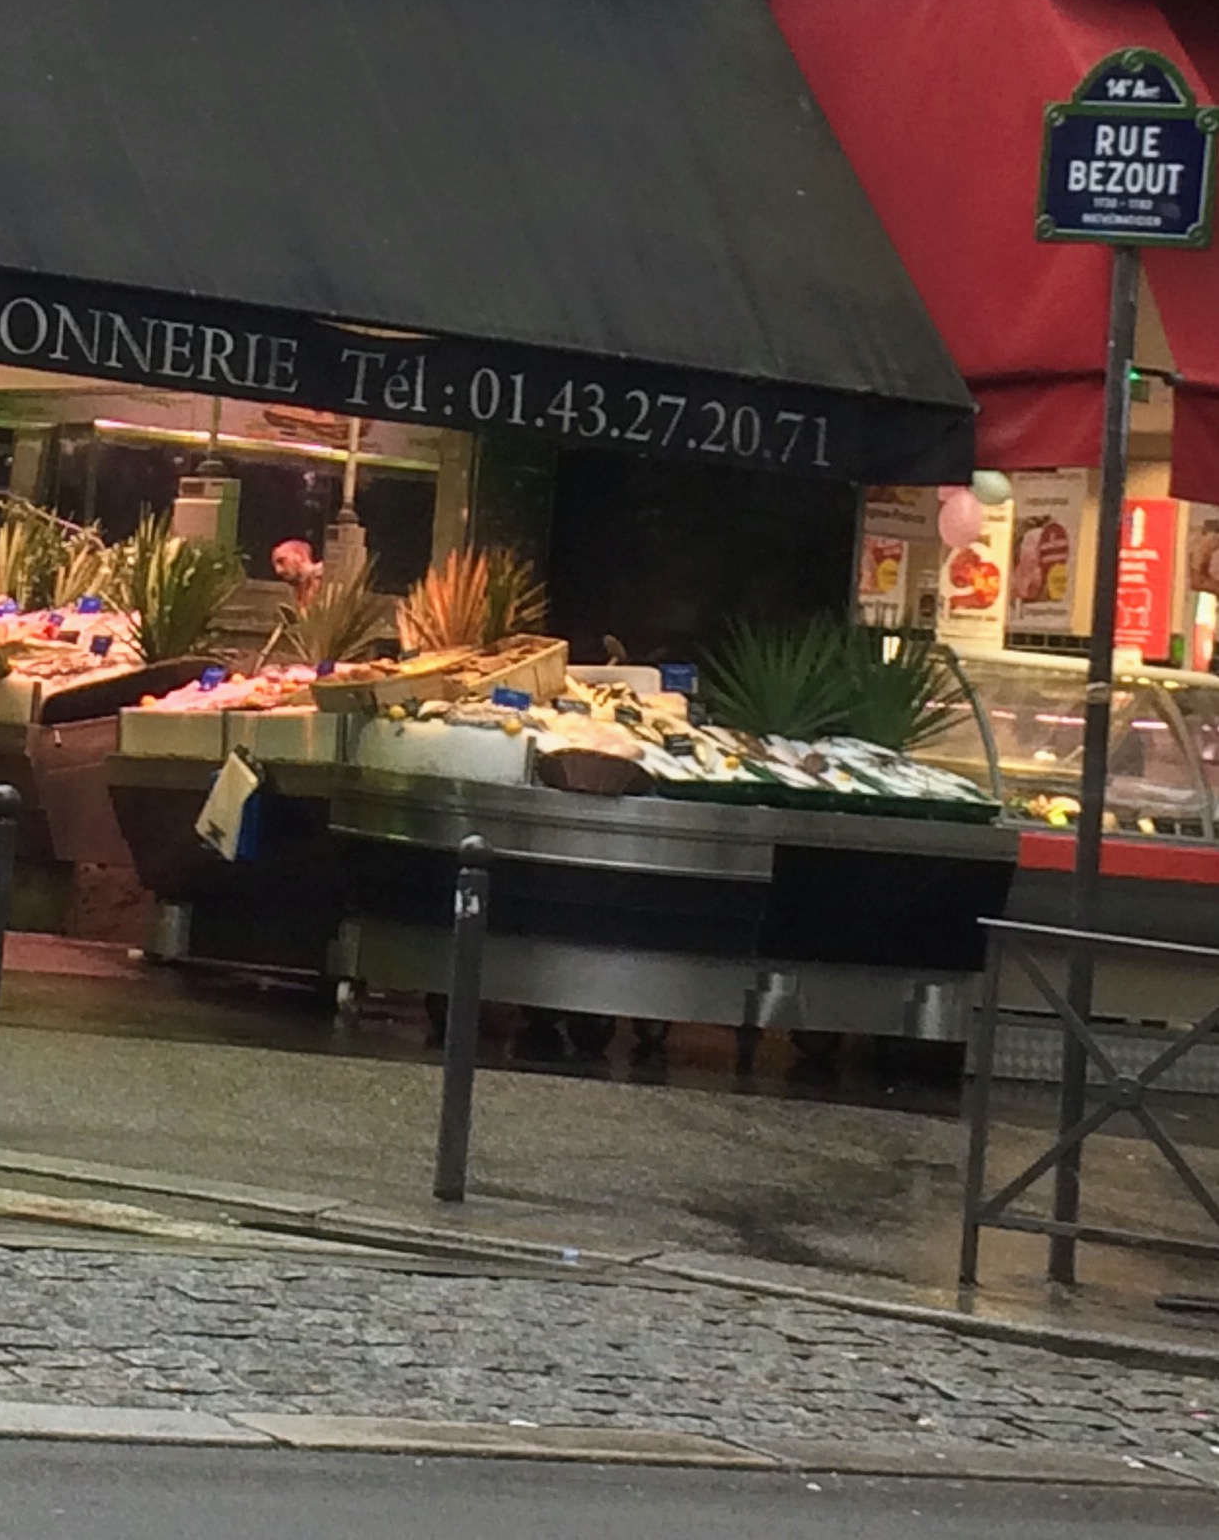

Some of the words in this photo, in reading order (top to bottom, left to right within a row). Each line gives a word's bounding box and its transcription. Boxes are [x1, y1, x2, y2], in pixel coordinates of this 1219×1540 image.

[1095, 124, 1162, 158] RUE
[1067, 160, 1184, 196] BEZOUT
[469, 367, 832, 467] 01.43.27.20.71
